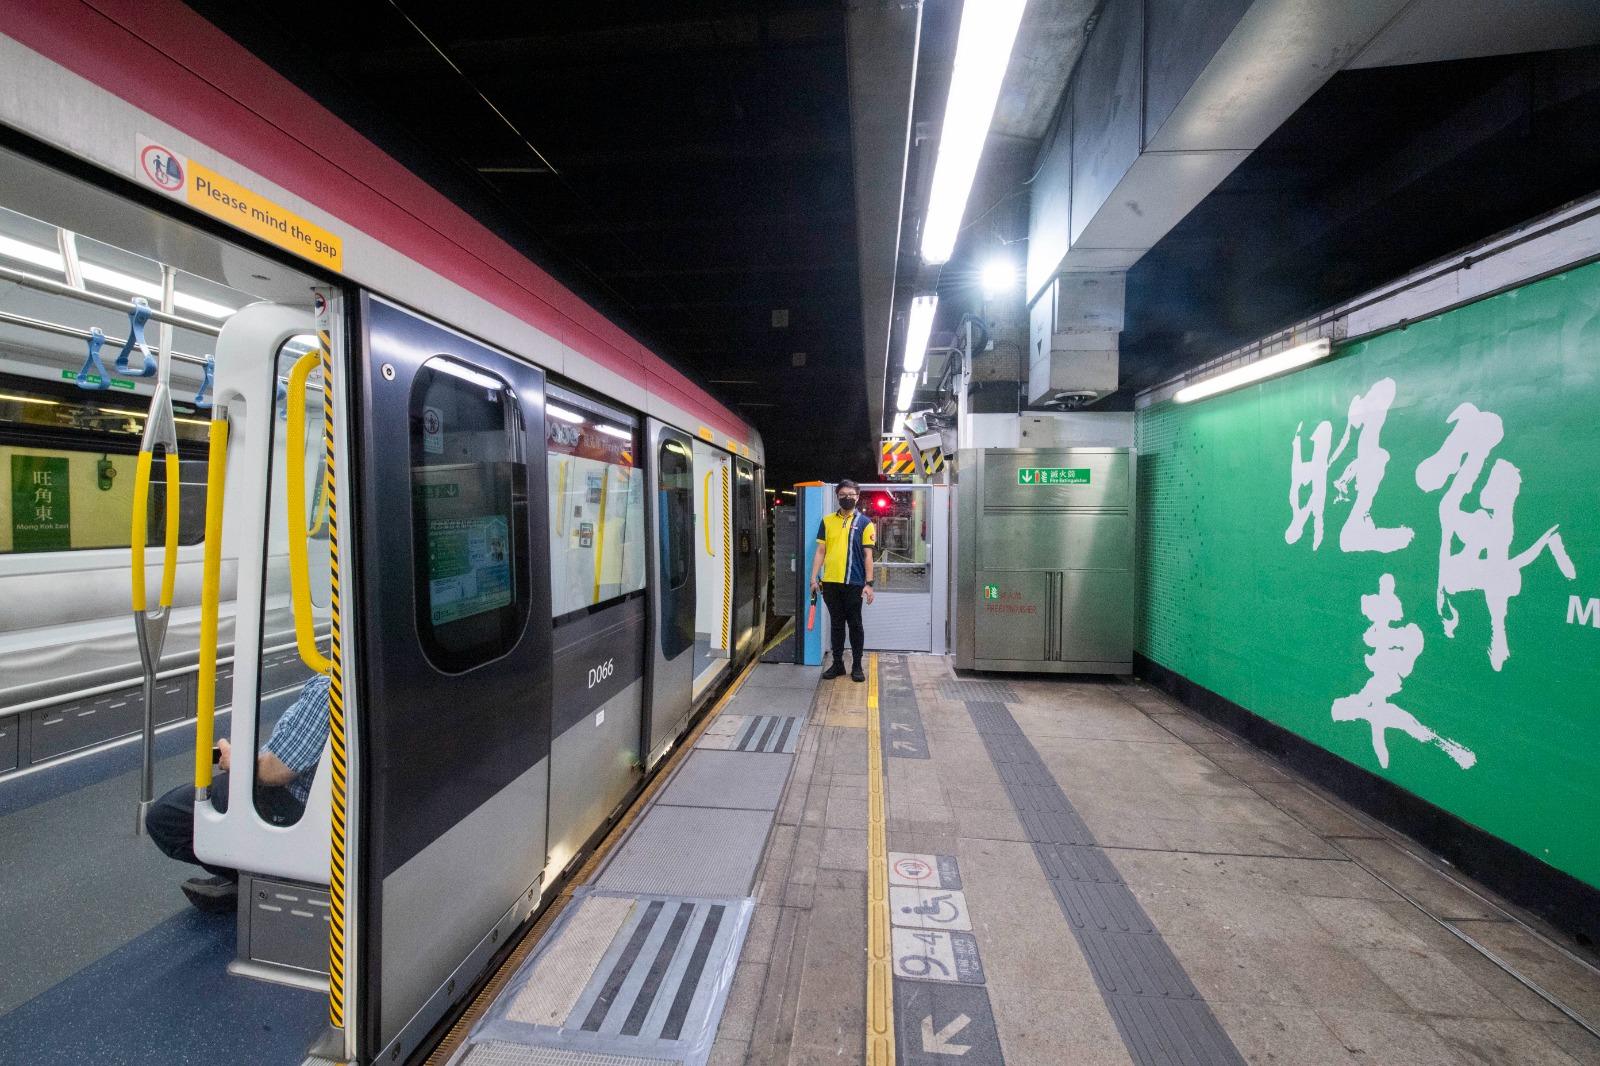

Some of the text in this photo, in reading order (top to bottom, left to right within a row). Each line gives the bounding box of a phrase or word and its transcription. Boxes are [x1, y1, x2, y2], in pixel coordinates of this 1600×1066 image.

[196, 176, 337, 258] Please mind the gap
[33, 471, 53, 521] 旺角東
[588, 657, 613, 689] D066
[899, 932, 950, 976] 9-4
